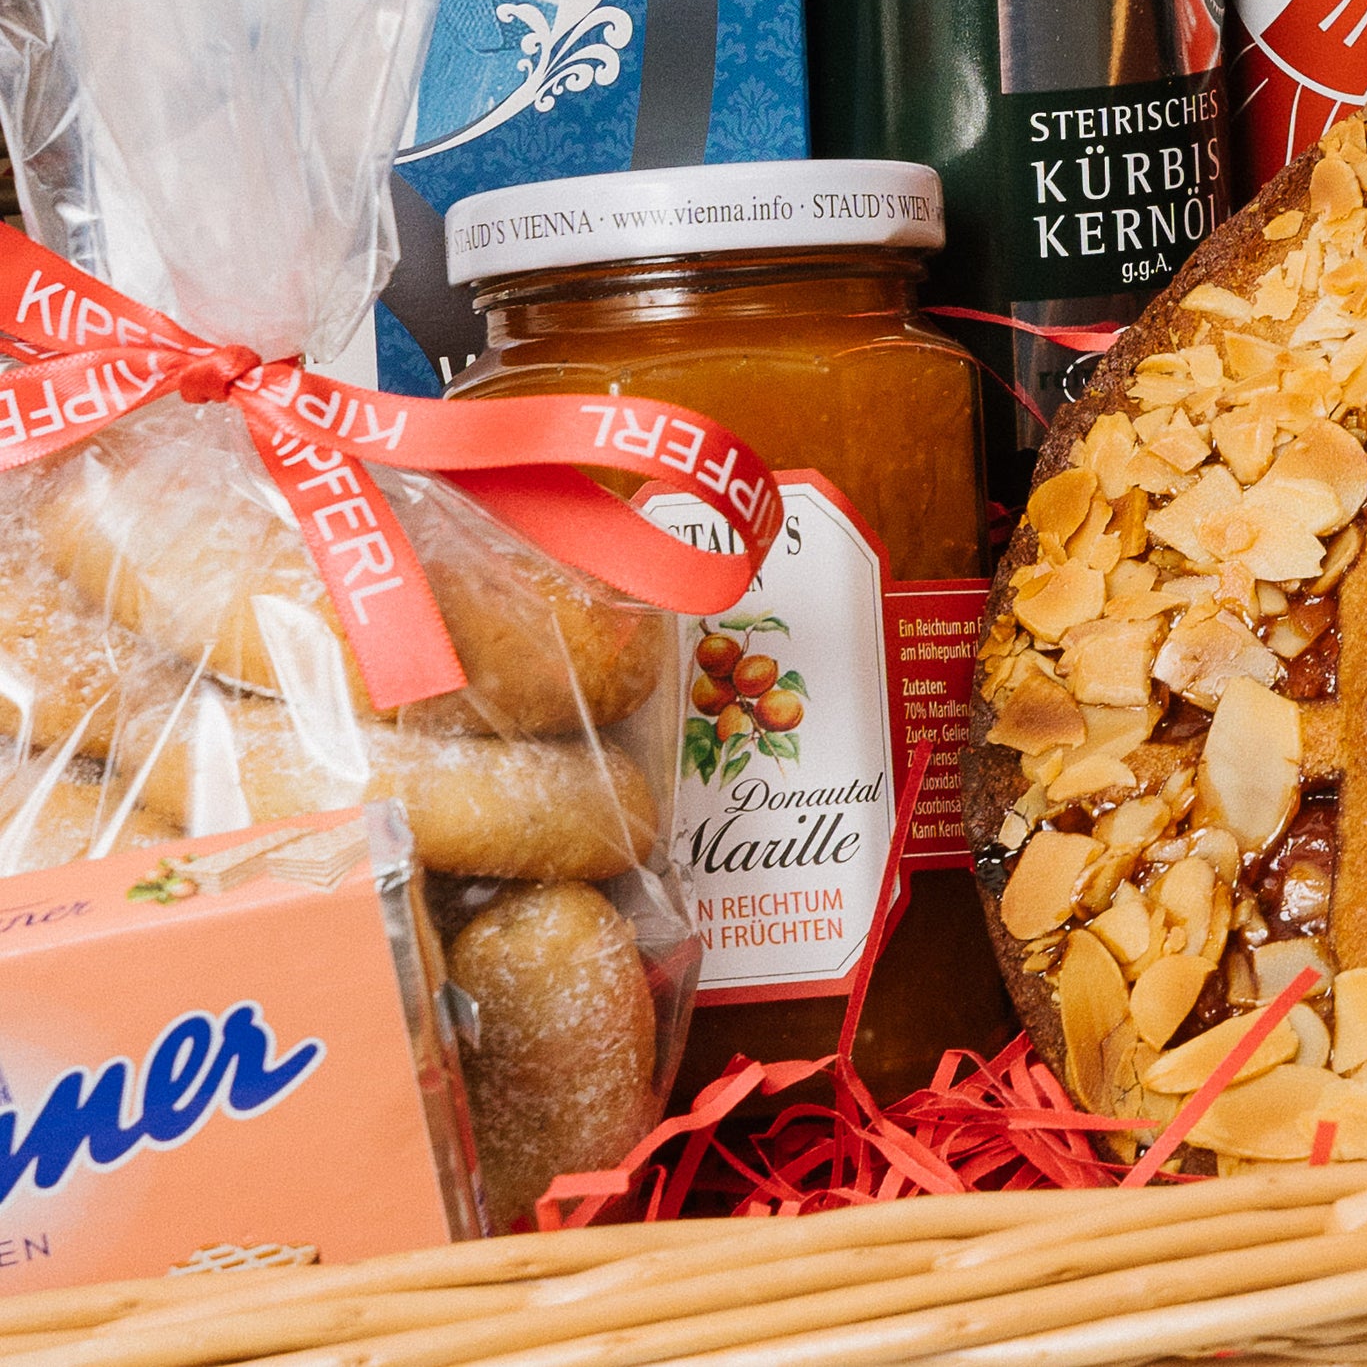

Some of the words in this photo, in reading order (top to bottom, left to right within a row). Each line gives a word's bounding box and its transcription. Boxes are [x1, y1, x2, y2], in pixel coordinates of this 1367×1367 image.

[1029, 89, 1219, 143] STEIRISCHES
[1030, 137, 1221, 204] KÜRBIS
[509, 209, 593, 241] VIENNA
[612, 193, 793, 230] www.vienna.info
[812, 193, 895, 219] STAUD'S
[898, 195, 931, 222] WIEN
[1121, 252, 1173, 284] g.g.A.
[898, 618, 915, 638] Ein
[915, 617, 962, 637] Reichtum
[963, 621, 976, 635] an
[900, 647, 916, 661] am
[917, 640, 972, 664] Höhepunkt
[902, 677, 947, 697] Zutaten:
[904, 702, 928, 720] 70%
[905, 725, 941, 745] Zucker,
[724, 772, 884, 815] Donautal
[911, 820, 937, 840] Kann
[722, 887, 844, 919] REICHTUM
[720, 917, 844, 950] FRÜCHTEN
